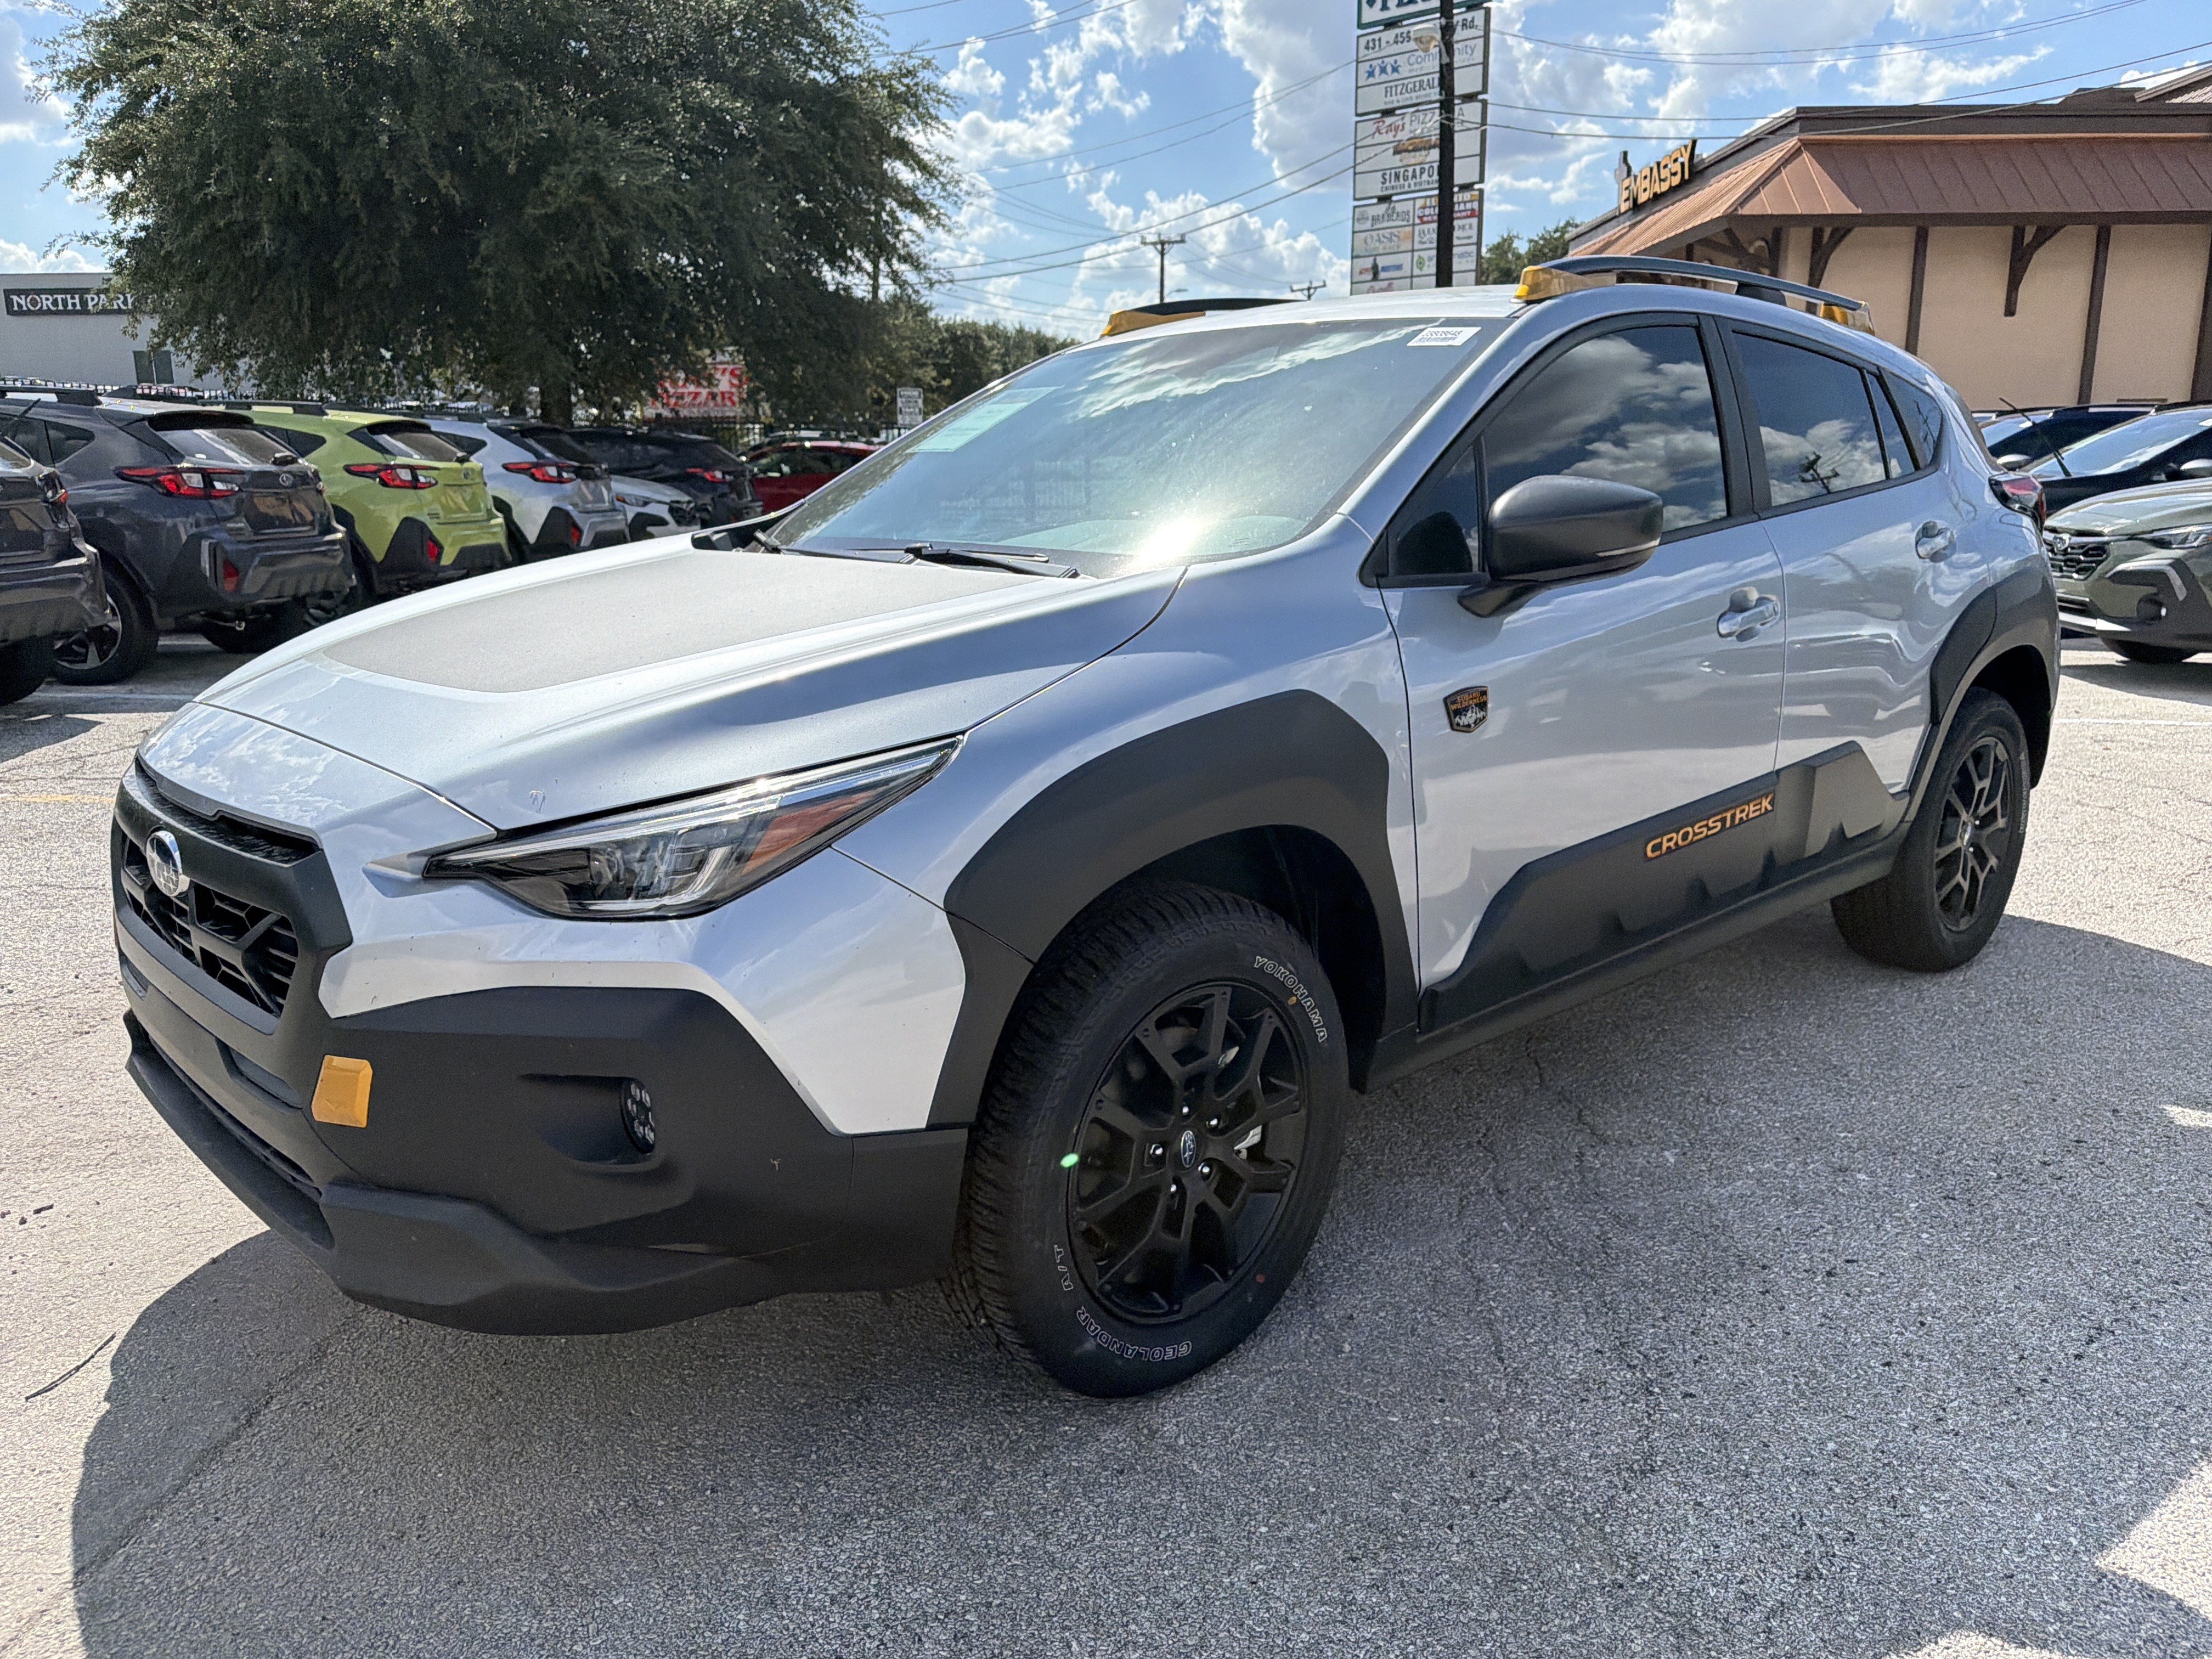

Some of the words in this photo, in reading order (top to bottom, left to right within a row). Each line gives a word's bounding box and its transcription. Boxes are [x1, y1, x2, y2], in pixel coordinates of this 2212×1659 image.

[1364, 37, 1381, 52] 431
[1393, 30, 1412, 46] 455
[1461, 18, 1478, 31] Rd.
[1381, 165, 1439, 185] SINGAPO
[1620, 139, 1695, 213] EMBASSY
[10, 294, 81, 311] NORTH
[1451, 695, 1487, 710] WILDERNESS
[1457, 691, 1481, 702] SUBARU
[1646, 792, 1775, 859] CROSSTREK
[1254, 956, 1328, 1043] YOKOHAMA
[1054, 1245, 1074, 1291] A/T
[1076, 1306, 1192, 1361] GEOLANDAR
